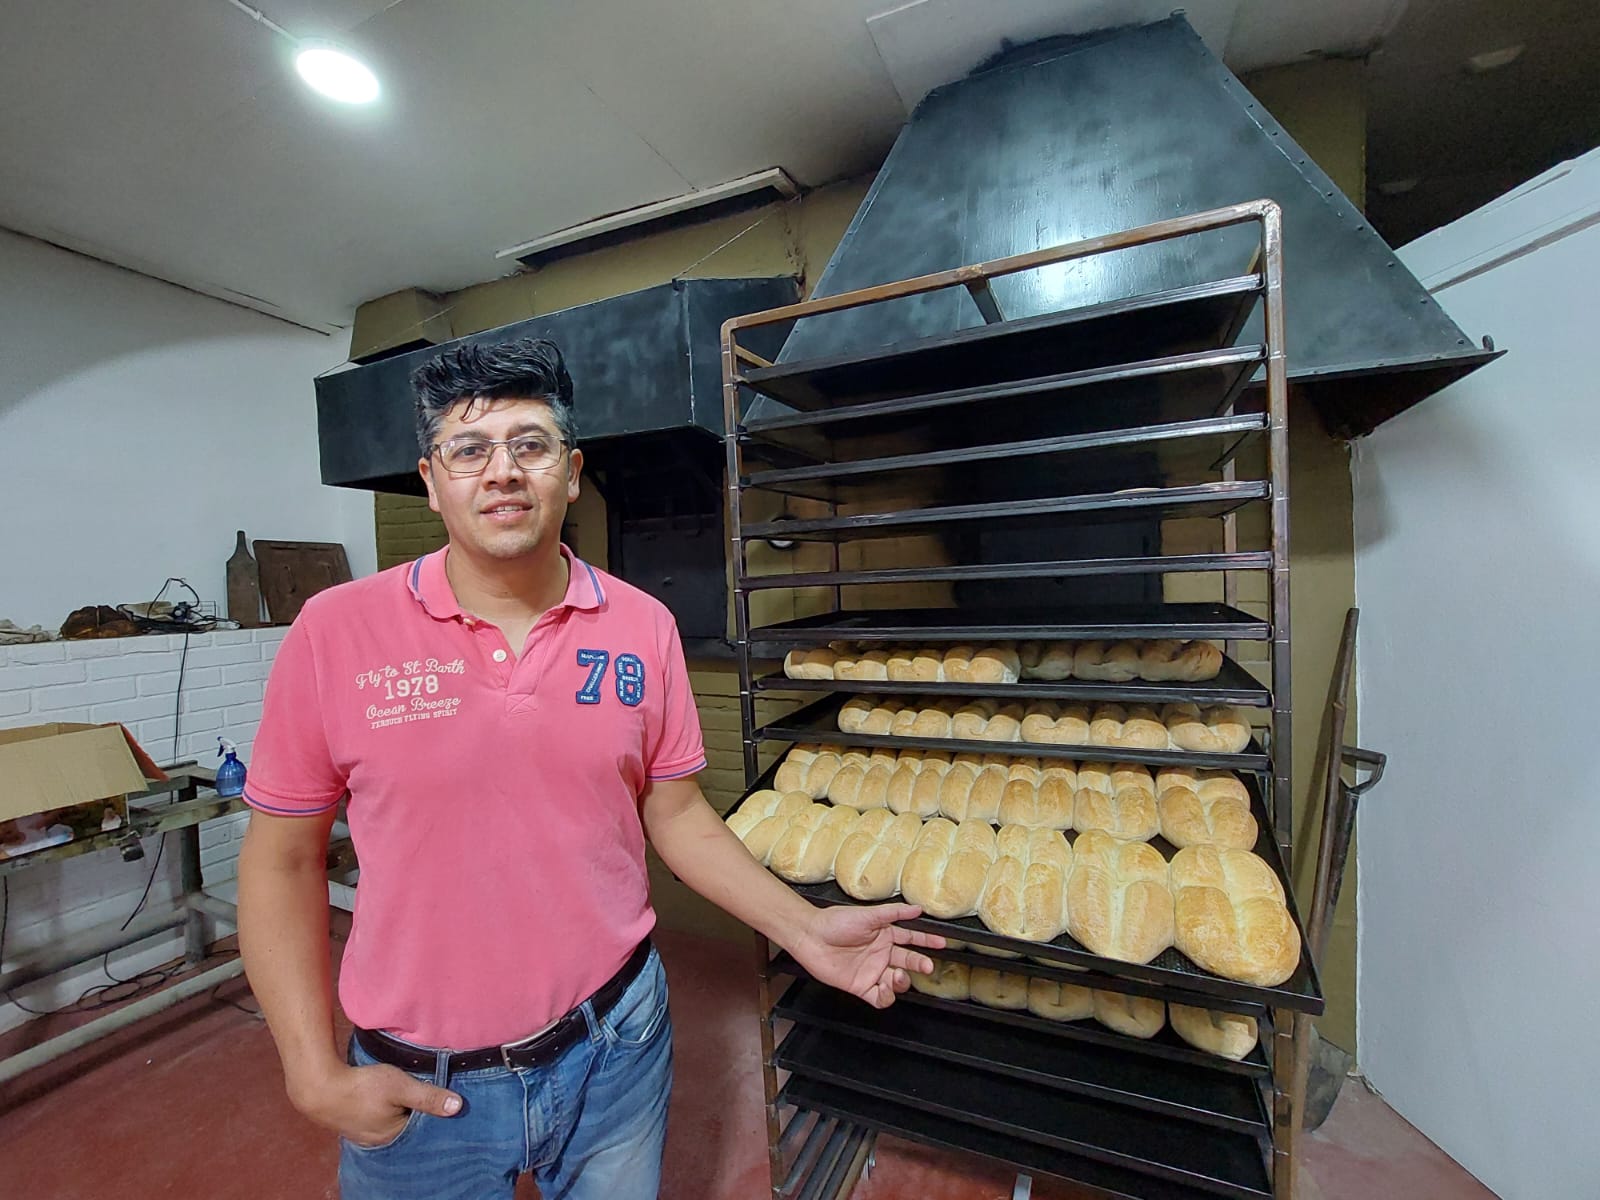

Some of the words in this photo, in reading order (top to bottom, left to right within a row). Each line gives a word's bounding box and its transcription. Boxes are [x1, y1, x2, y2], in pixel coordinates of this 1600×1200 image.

[355, 670, 382, 690] Fly
[379, 665, 400, 678] to
[402, 660, 422, 675] St
[425, 658, 465, 674] Barth
[385, 674, 439, 700] 1978
[576, 649, 645, 708] 78
[366, 704, 406, 719] Ocean
[411, 697, 461, 711] Breeze
